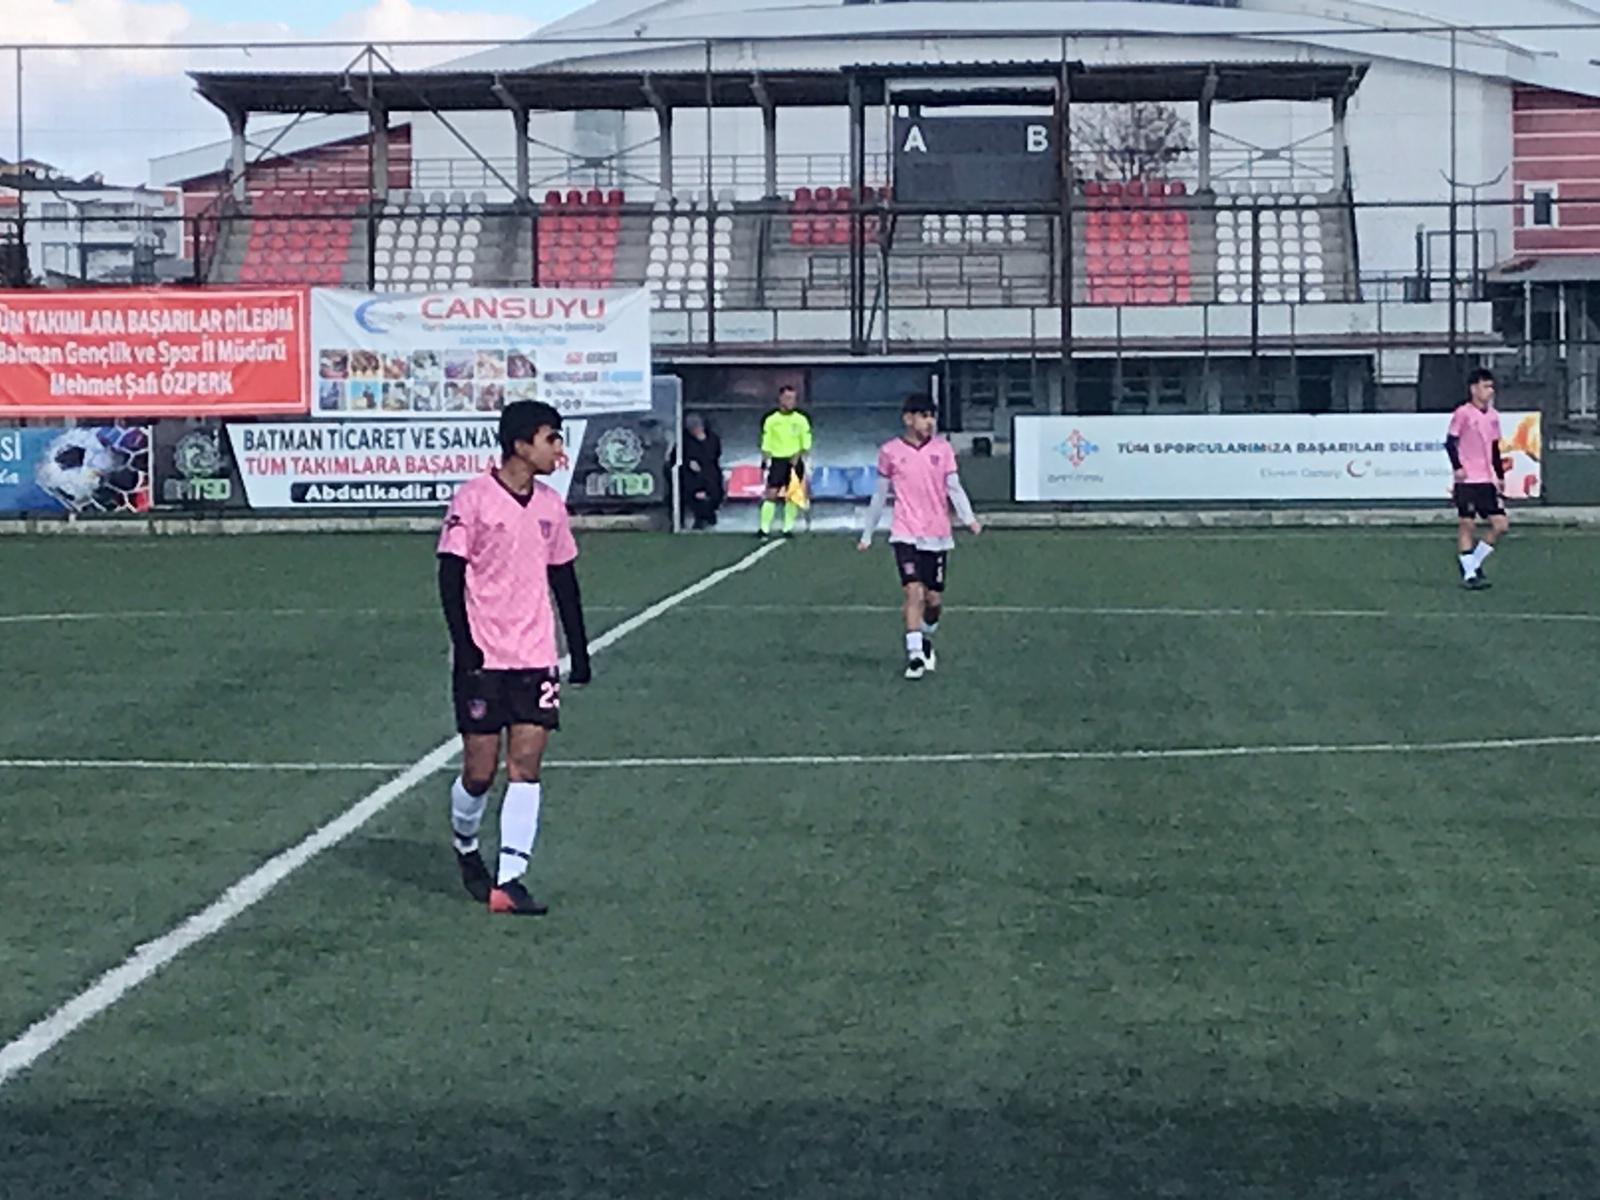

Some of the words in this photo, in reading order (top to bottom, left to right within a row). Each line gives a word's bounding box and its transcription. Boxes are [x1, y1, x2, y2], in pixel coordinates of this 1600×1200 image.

[903, 124, 927, 152] A
[1026, 125, 1049, 152] B
[26, 310, 125, 334] TAKIMLARA
[128, 309, 222, 339] BAŞARILAR
[224, 301, 294, 333] DİLERİM
[421, 297, 606, 320] CANSUYU
[65, 341, 133, 369] Gençlik
[134, 345, 157, 364] ve
[158, 340, 200, 372] Spor
[201, 334, 215, 362] İl
[217, 337, 287, 362] Müdürü
[50, 372, 123, 397] Mehmet
[161, 369, 234, 396] ÖZPERK
[243, 429, 323, 450] BATMAN
[327, 427, 404, 449] TİCARET
[410, 427, 435, 449] VE
[438, 427, 501, 449] SANAY
[1117, 440, 1149, 454] TÜM
[1154, 442, 1292, 454] SPORCULARIMIZA
[1297, 442, 1384, 455] BAŞARILAR
[1389, 439, 1447, 452] DİLERİ
[244, 453, 287, 475] TÜM
[291, 456, 400, 475] TAKIMLARA
[405, 454, 497, 479] BAŞARILA
[305, 484, 432, 501] Abdulkadir
